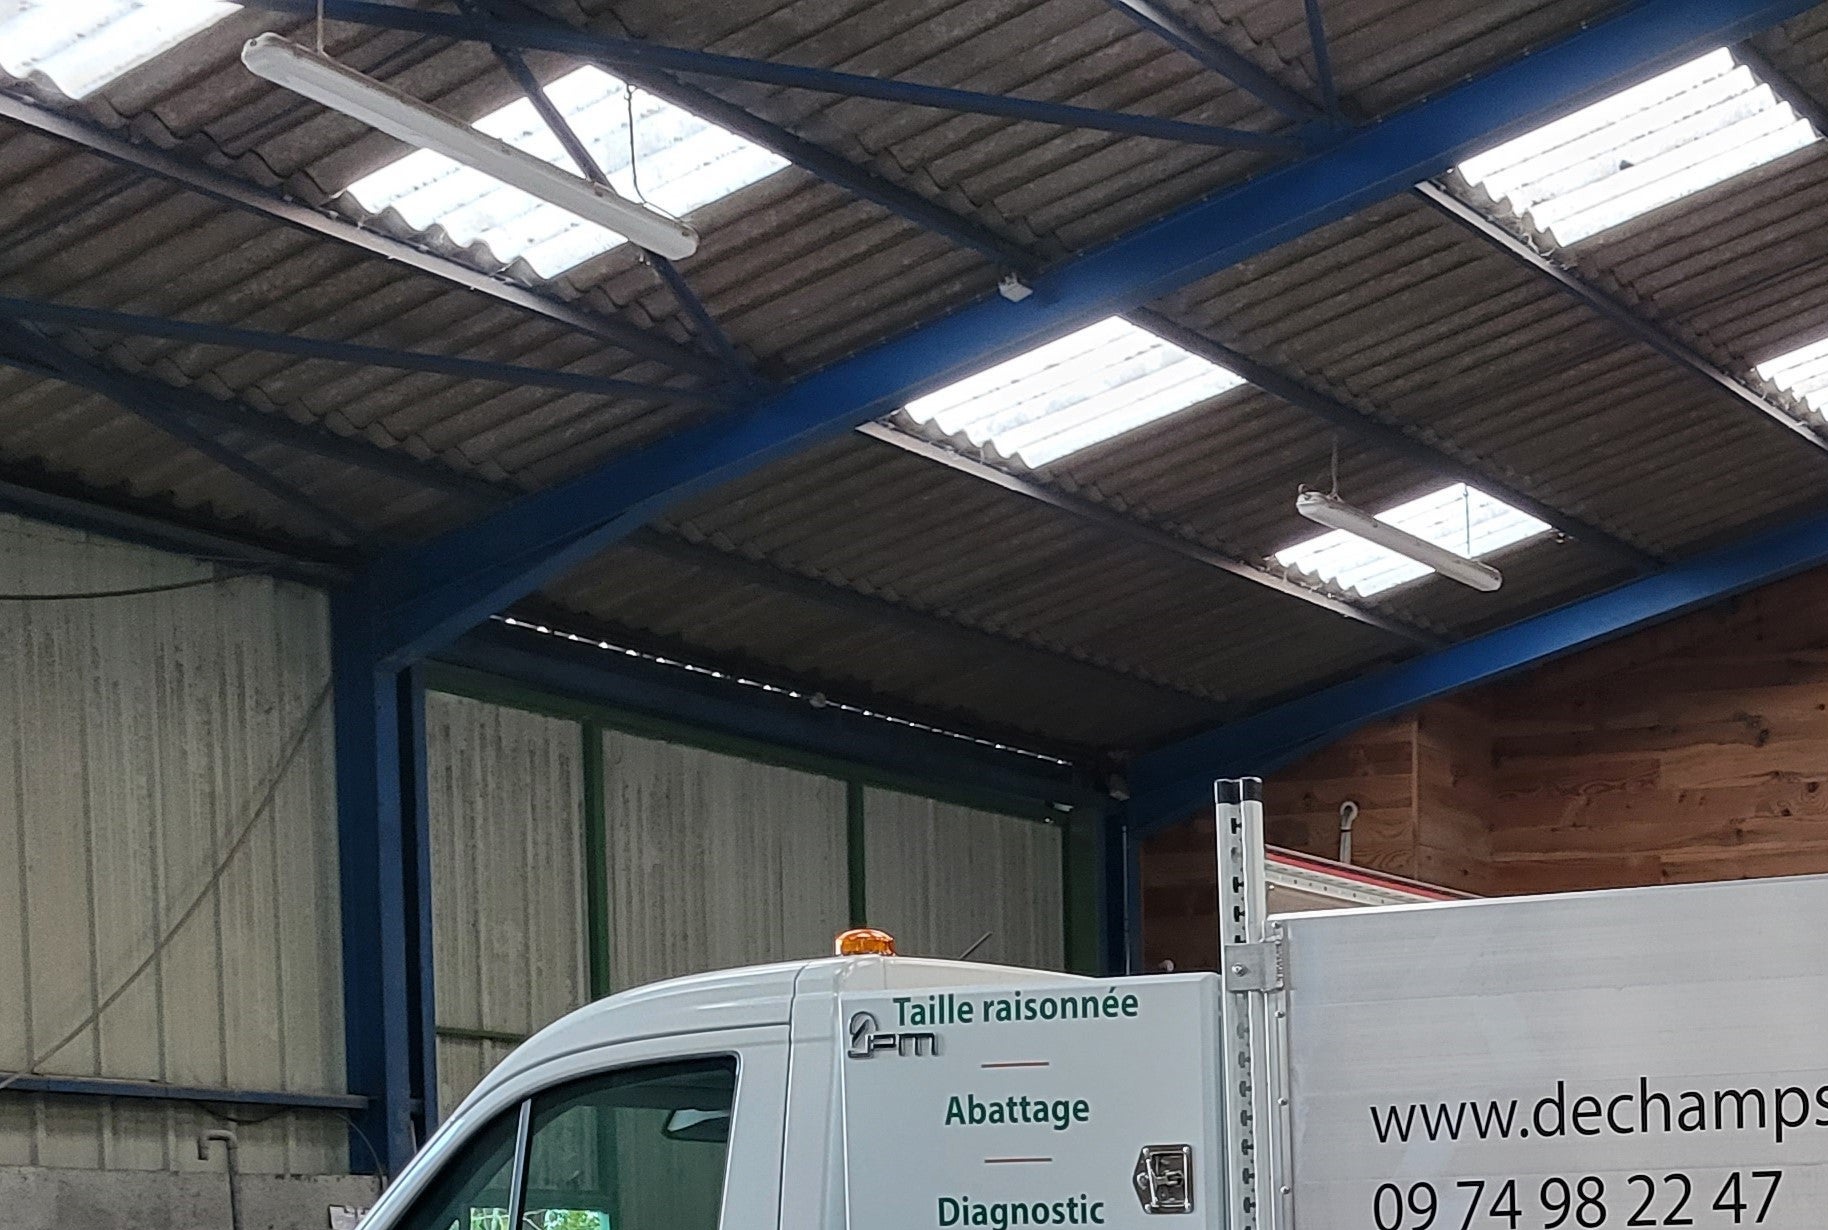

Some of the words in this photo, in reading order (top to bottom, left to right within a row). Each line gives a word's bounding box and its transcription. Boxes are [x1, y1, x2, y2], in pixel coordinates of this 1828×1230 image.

[892, 993, 974, 1027] Taille
[983, 986, 1139, 1023] raisonnée
[944, 1093, 1090, 1131] Abattage
[1540, 1175, 1607, 1230] 98
[1626, 1173, 1694, 1227] 22
[1712, 1170, 1783, 1224] 47
